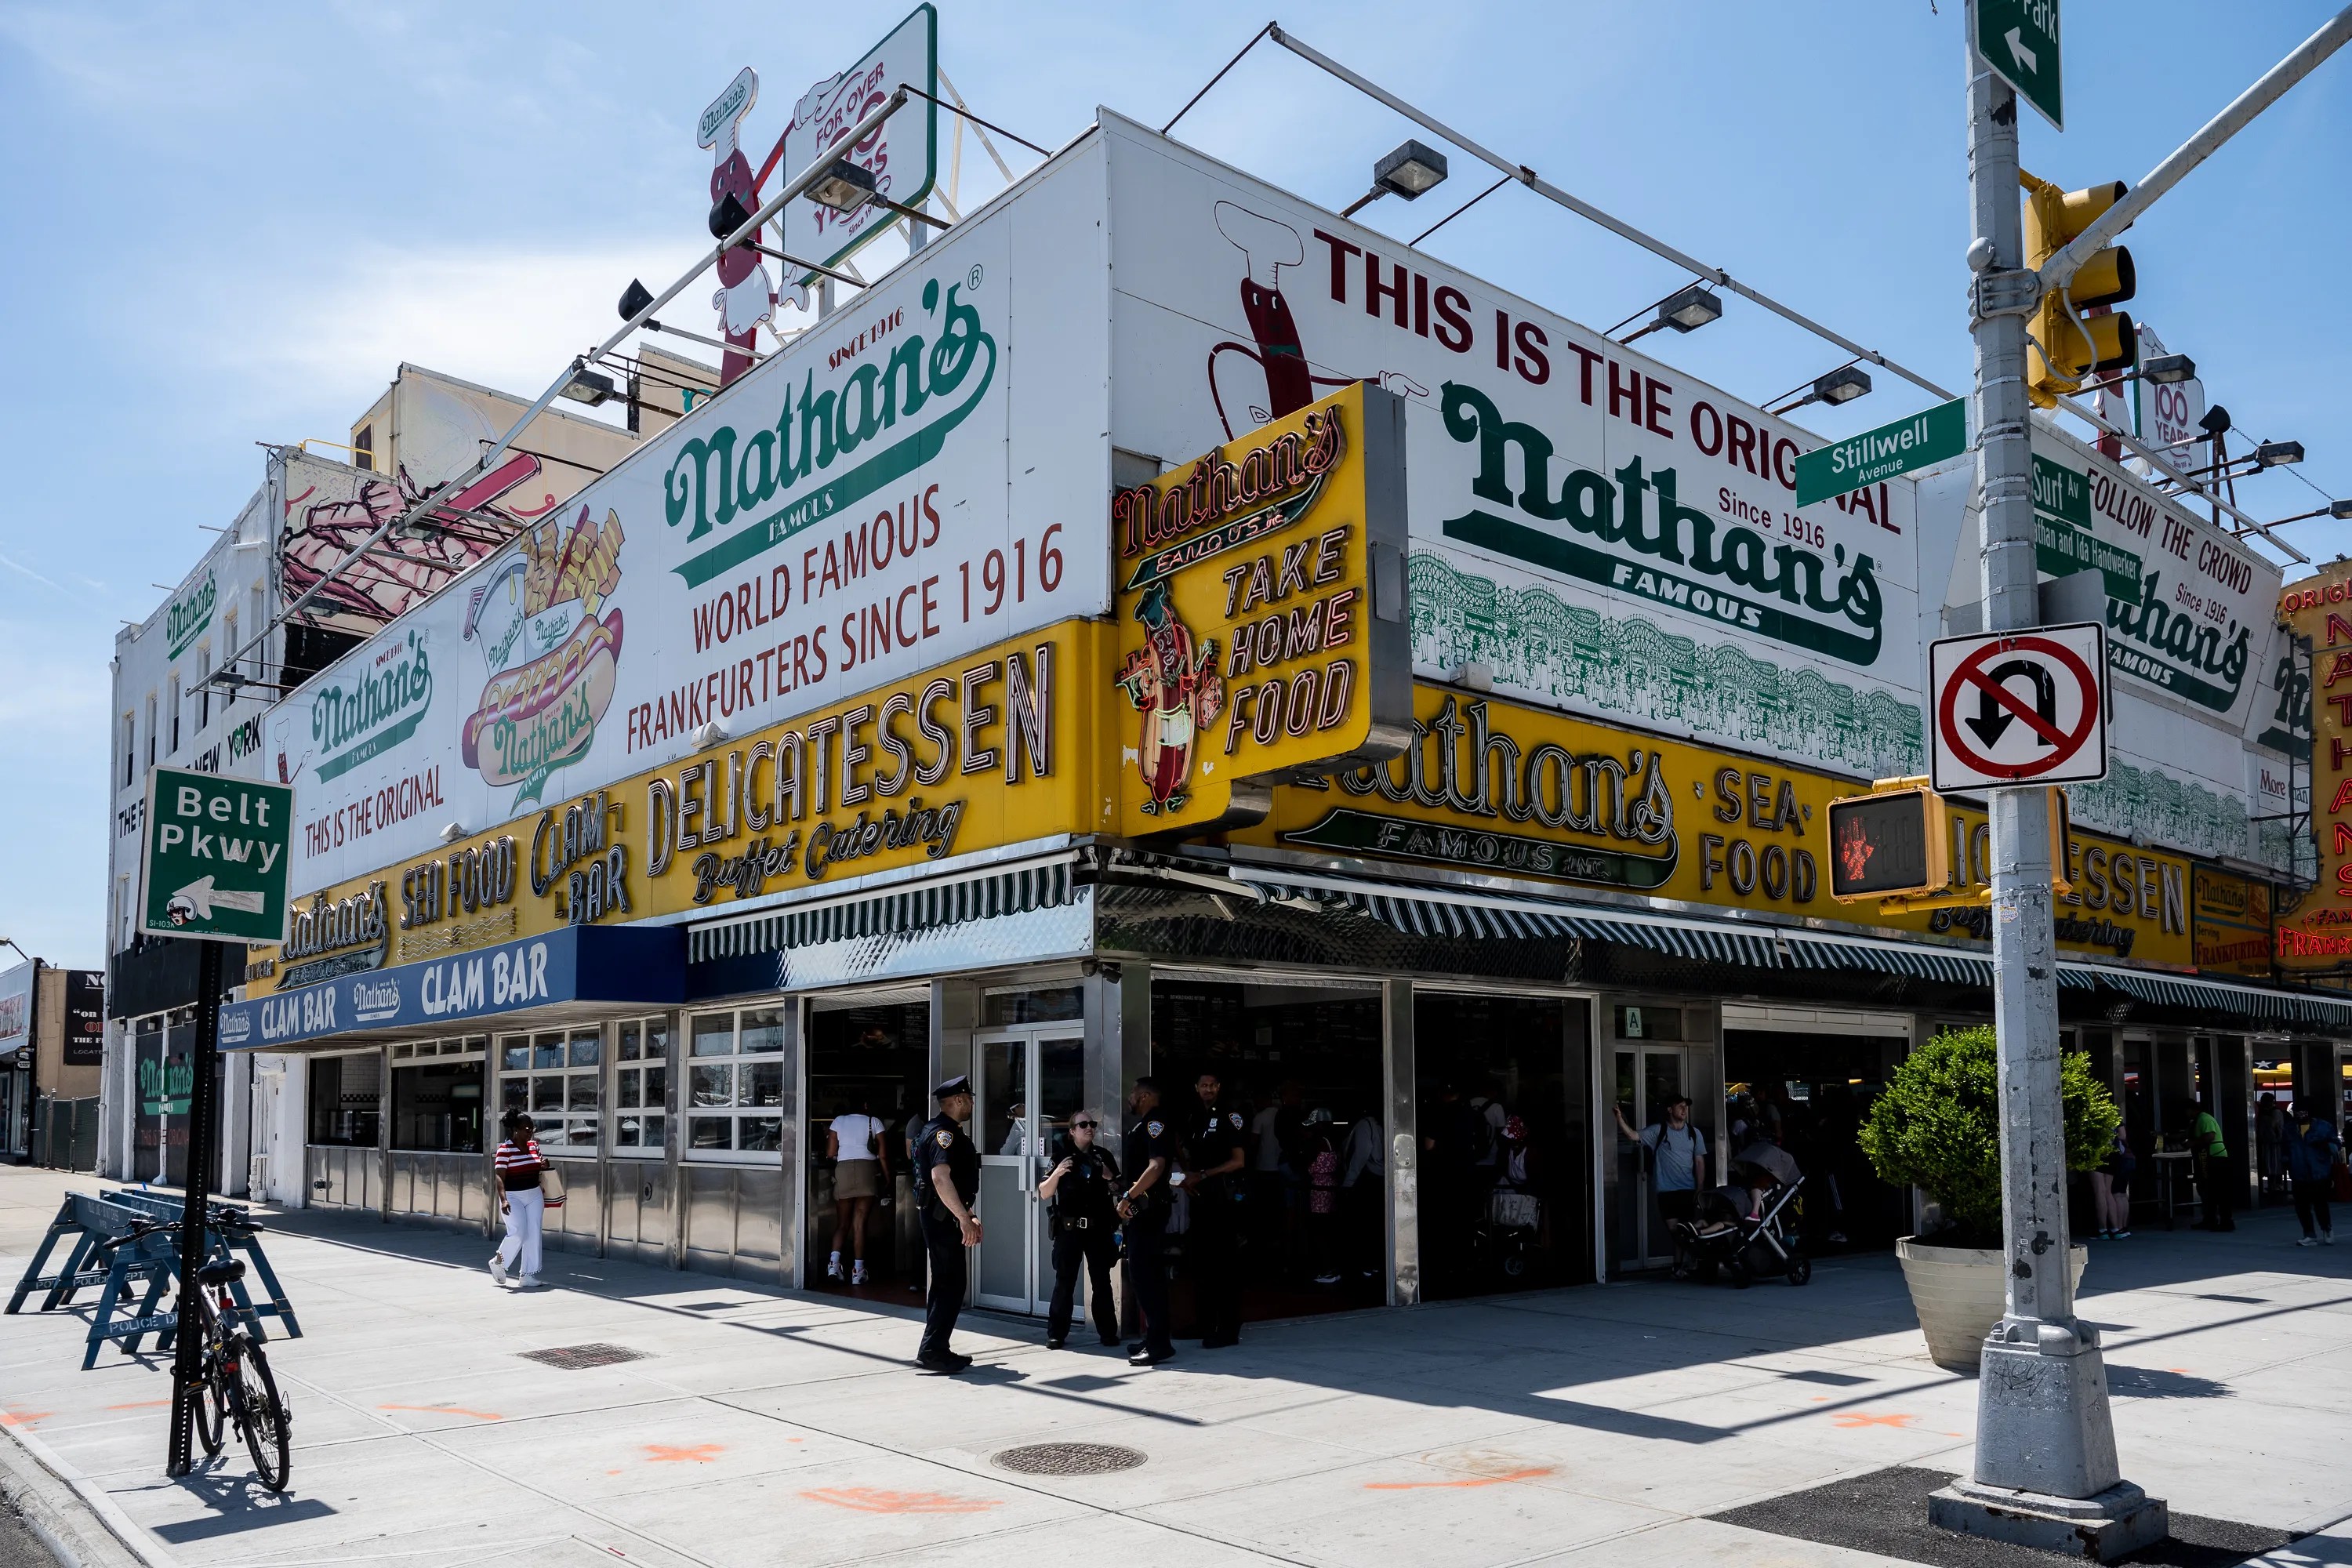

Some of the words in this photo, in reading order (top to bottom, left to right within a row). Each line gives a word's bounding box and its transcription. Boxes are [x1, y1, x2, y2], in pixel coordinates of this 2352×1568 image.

[702, 82, 746, 132] Nathan's
[816, 107, 843, 148] FOR
[847, 61, 884, 114] OVER
[817, 91, 887, 161] 00
[849, 218, 864, 236] Since
[828, 333, 869, 372] SINCE
[869, 306, 905, 343] 1916
[664, 278, 986, 543] Nathan's
[1314, 228, 1473, 353] THIS
[1496, 309, 1551, 385] IS
[1568, 341, 1673, 440] THE
[1690, 401, 1902, 535] ORIGAL
[2154, 385, 2188, 427] 100
[1832, 416, 1928, 474] Stillwell
[1858, 459, 1904, 483] Avenue
[1114, 403, 1347, 560] Nathan's
[1441, 379, 1882, 628] Nathan's
[2032, 463, 2063, 510] Surf
[2067, 477, 2078, 499] Av
[769, 489, 834, 542] FAMOUS
[1156, 517, 1261, 574] FAMOUS
[1719, 487, 1772, 528] Since
[1783, 512, 1825, 549] 1916
[2088, 467, 2157, 539] FOLLOW
[2161, 514, 2194, 561] THE
[2198, 540, 2251, 595] CROWD
[694, 564, 790, 654] WORLD
[804, 484, 940, 605] FAMOUS
[1223, 524, 1354, 620] TAKE
[2034, 517, 2056, 549] than
[2059, 532, 2074, 556] and
[2077, 533, 2089, 562] Ida
[2092, 539, 2136, 580] Handwerker
[167, 568, 216, 648] Nathan's
[1613, 563, 1762, 627] FAMOUS
[2176, 583, 2201, 612] Since
[2204, 598, 2227, 625] 1916
[628, 625, 826, 754] FRANKFURTERS
[841, 575, 940, 673] SINCE
[959, 524, 1062, 623] 1916
[1228, 588, 1362, 678] HOME
[2107, 644, 2175, 685] FAMOUS
[313, 629, 433, 755] Nathan's
[1225, 659, 1358, 755] FOOD
[194, 742, 221, 773] NEW
[493, 681, 591, 777] Nathan's
[647, 641, 1056, 877] DELICATESSEN
[524, 767, 547, 791] FAMOUS
[1295, 695, 1674, 845] athan's
[2260, 769, 2286, 796] More
[119, 804, 137, 839] THE
[177, 786, 270, 827] Belt
[305, 815, 330, 859] THIS
[334, 808, 344, 848] IS
[348, 796, 372, 841] THE
[376, 764, 444, 829] ORIGINAL
[1714, 768, 1805, 836] SEA
[159, 823, 281, 874] Pkwy
[530, 789, 609, 898] CLAM
[692, 830, 801, 904] Buffet
[805, 797, 967, 880] Catering
[1377, 822, 1555, 869] FAMOUS
[1700, 833, 1817, 903] FOOD
[400, 859, 443, 930] SEA
[448, 834, 517, 917] FOOD
[568, 843, 632, 926] BAR
[2196, 924, 2220, 941] Serving
[2196, 935, 2270, 965] FRANKFURTERS
[245, 964, 255, 982] ALL
[256, 959, 274, 978] YEAR
[354, 978, 401, 1011] Nathan's
[421, 956, 484, 1014] CLAM
[492, 942, 549, 1005] BAR
[220, 1009, 251, 1035] Nathan's
[261, 995, 299, 1040] CLAM
[303, 985, 336, 1033] BAR
[1630, 1012, 1639, 1028] A
[125, 1271, 146, 1282] EPT.
[109, 1316, 158, 1333] POLICE
